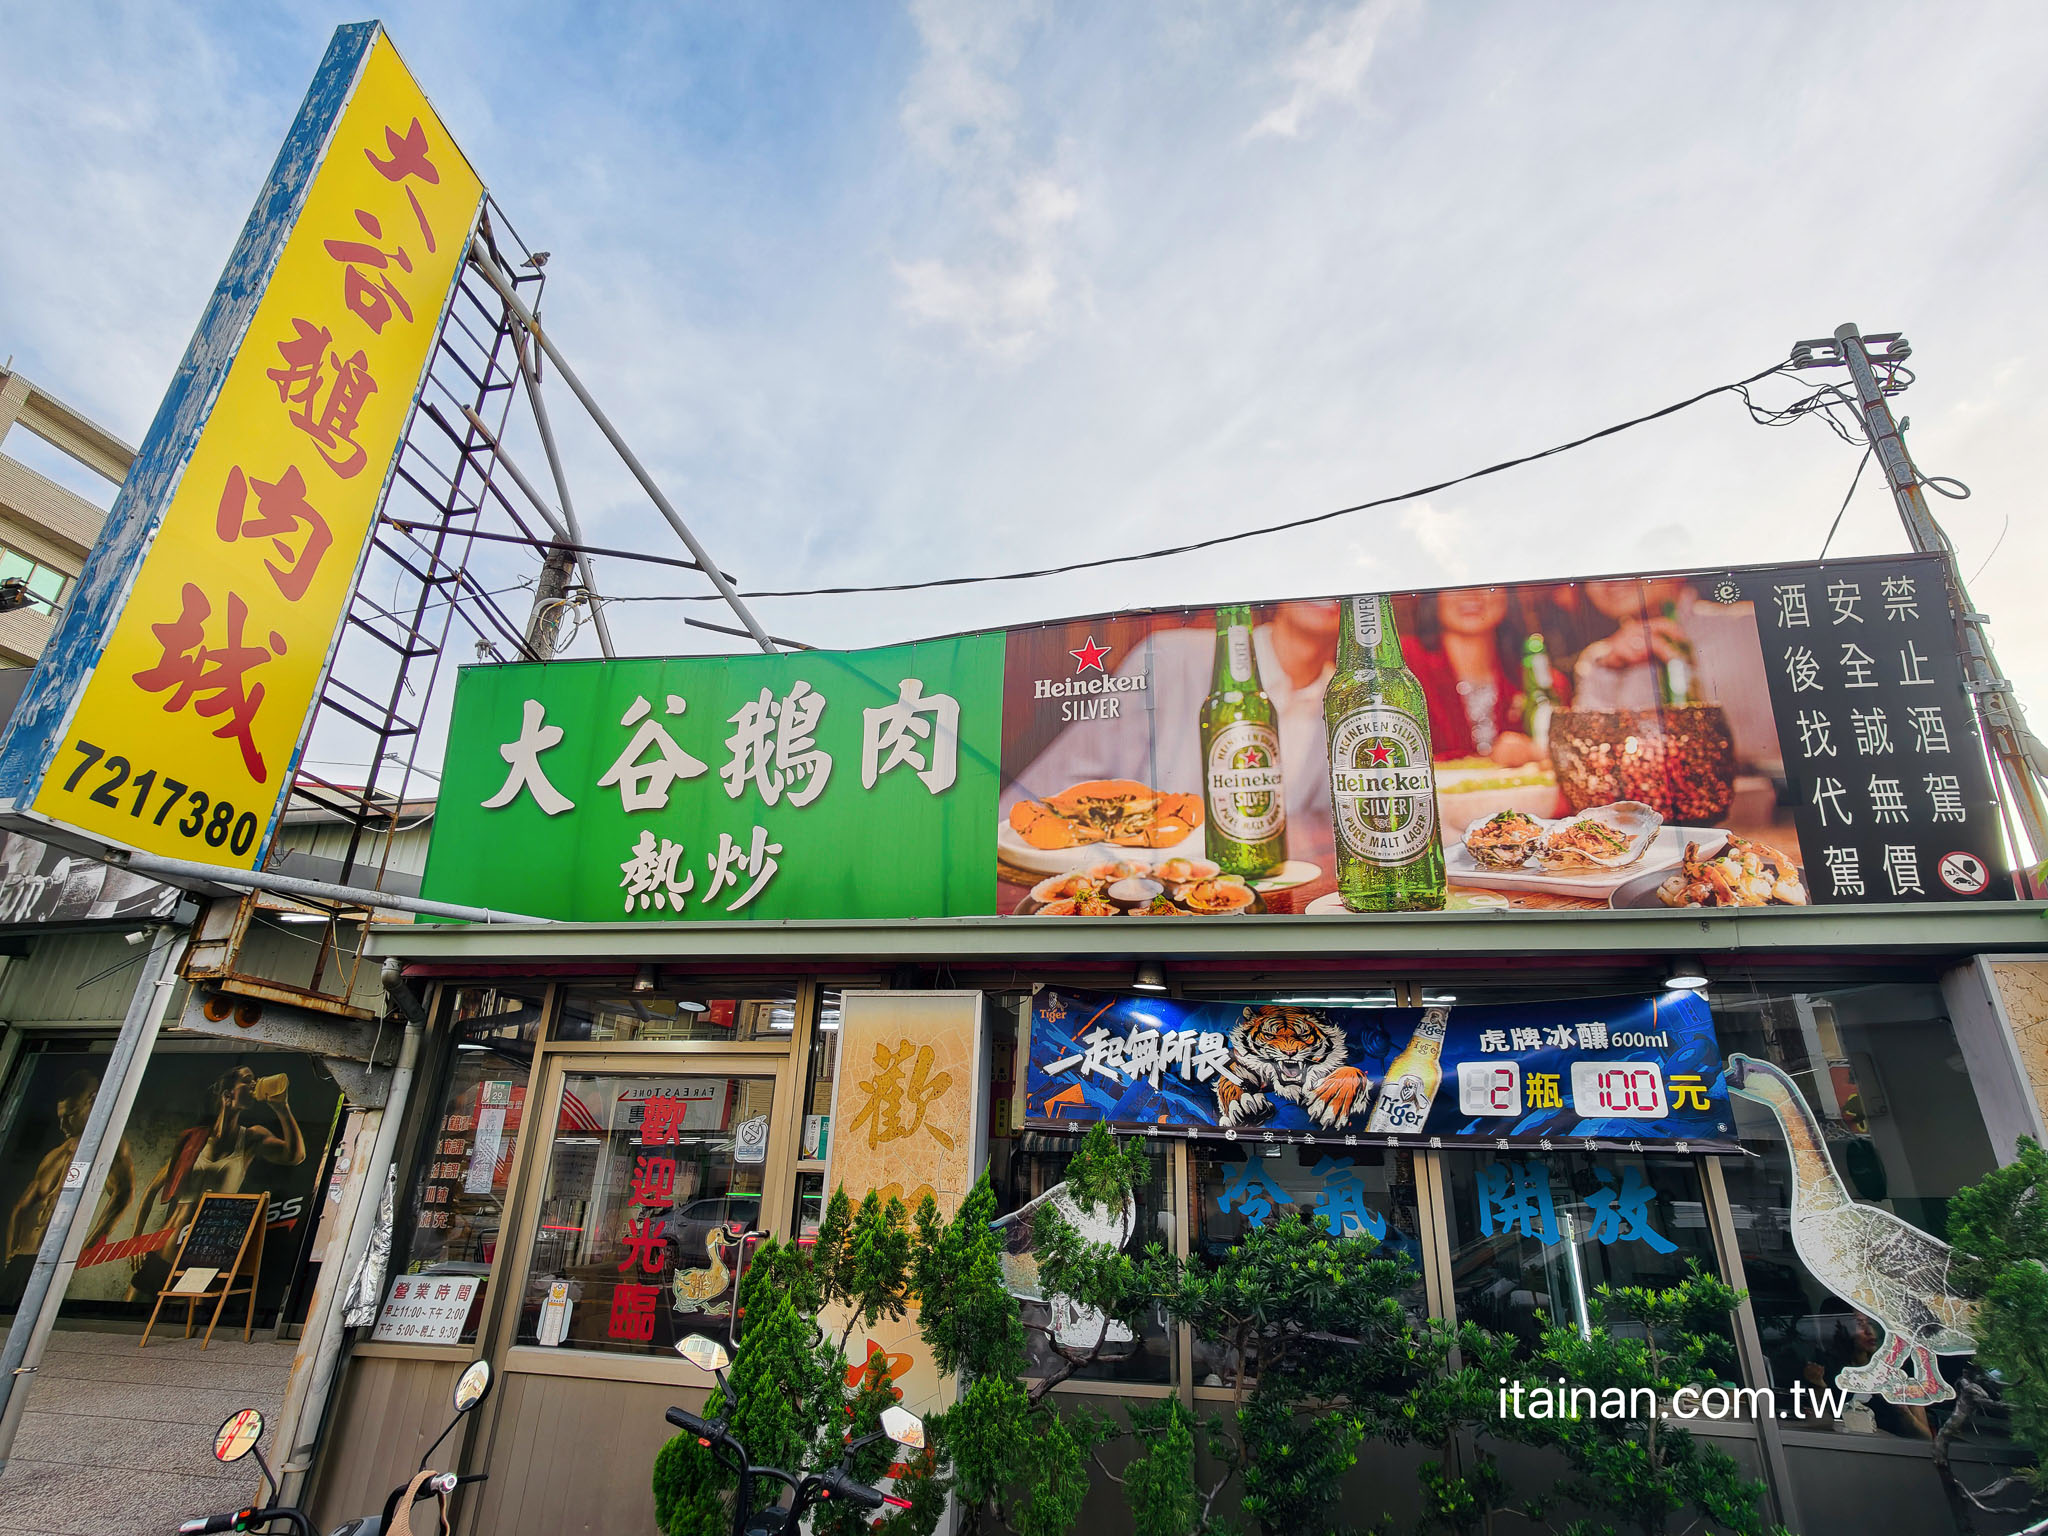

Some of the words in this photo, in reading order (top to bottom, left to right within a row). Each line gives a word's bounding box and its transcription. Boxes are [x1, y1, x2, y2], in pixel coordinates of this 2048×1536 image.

[133, 117, 440, 783] 大谷鵝肉城
[1359, 597, 1377, 635] SILVER
[1034, 674, 1147, 699] Heineken
[1880, 575, 1966, 824] 禁止酒駕
[1061, 697, 1120, 721] SILVER
[480, 678, 960, 815] 大谷鵝肉
[1338, 721, 1389, 756] HEINEKEN
[1773, 583, 1865, 896] 酒後找代駕
[1827, 579, 1925, 895] 安全誠無價
[63, 740, 258, 857] 7217380
[1336, 773, 1430, 792] Heineken
[1362, 798, 1408, 816] SILVER
[1344, 816, 1367, 842] PURE
[1369, 836, 1400, 849] MALT
[1403, 814, 1428, 845] LAGER
[619, 825, 783, 913] 熱炒
[1040, 1009, 1067, 1023] Tiger
[1417, 1022, 1446, 1036] Tiger
[1480, 1022, 1609, 1053] 虎牌冰釀
[1611, 1031, 1669, 1048] 600ml
[1040, 1025, 1244, 1093] 一起無所畏
[1491, 1069, 1513, 1109] 2
[1526, 1072, 1563, 1109] 瓶
[1598, 1069, 1659, 1111] 100
[1668, 1074, 1711, 1111] 元
[1379, 1094, 1423, 1126] Tiger
[608, 1095, 687, 1341] 歡迎光臨
[394, 1281, 472, 1302] 營業時間
[445, 1308, 465, 1320] 2:00
[439, 1326, 459, 1339] 9:30
